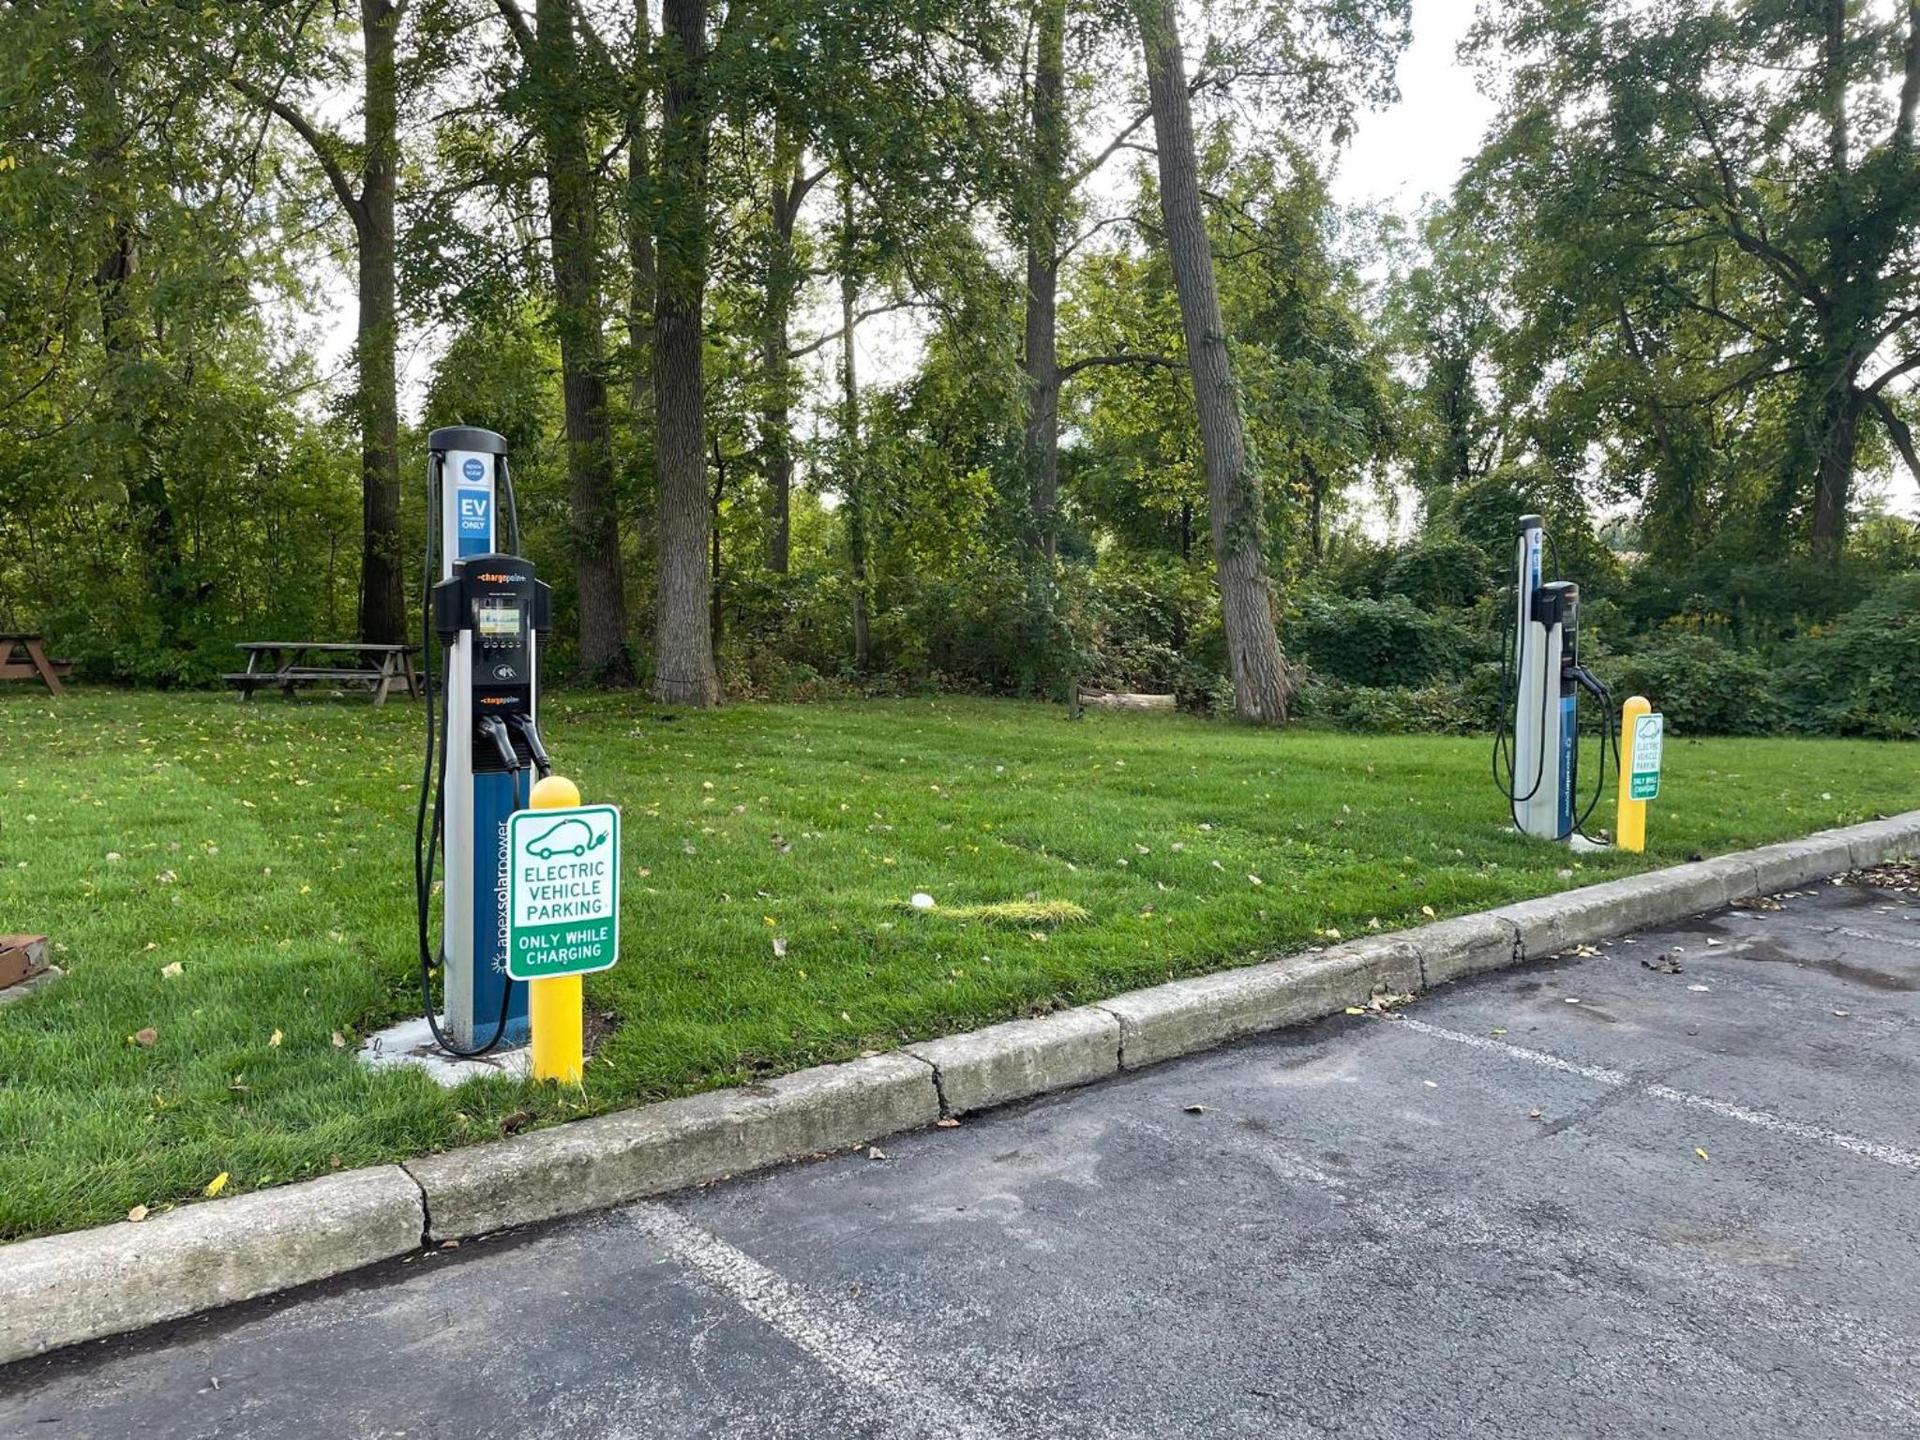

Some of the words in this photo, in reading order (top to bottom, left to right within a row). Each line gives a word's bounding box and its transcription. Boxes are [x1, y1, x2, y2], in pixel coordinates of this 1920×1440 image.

[462, 499, 487, 516] EV
[462, 521, 485, 530] ONLY
[525, 861, 604, 883] ELECTRIC
[494, 822, 508, 947] apexsolarpower
[529, 880, 601, 900] VEHICLE
[527, 899, 602, 920] PARKING
[519, 933, 560, 949] ONLY
[566, 927, 608, 944] WHILE
[526, 944, 602, 964] CHARGING
